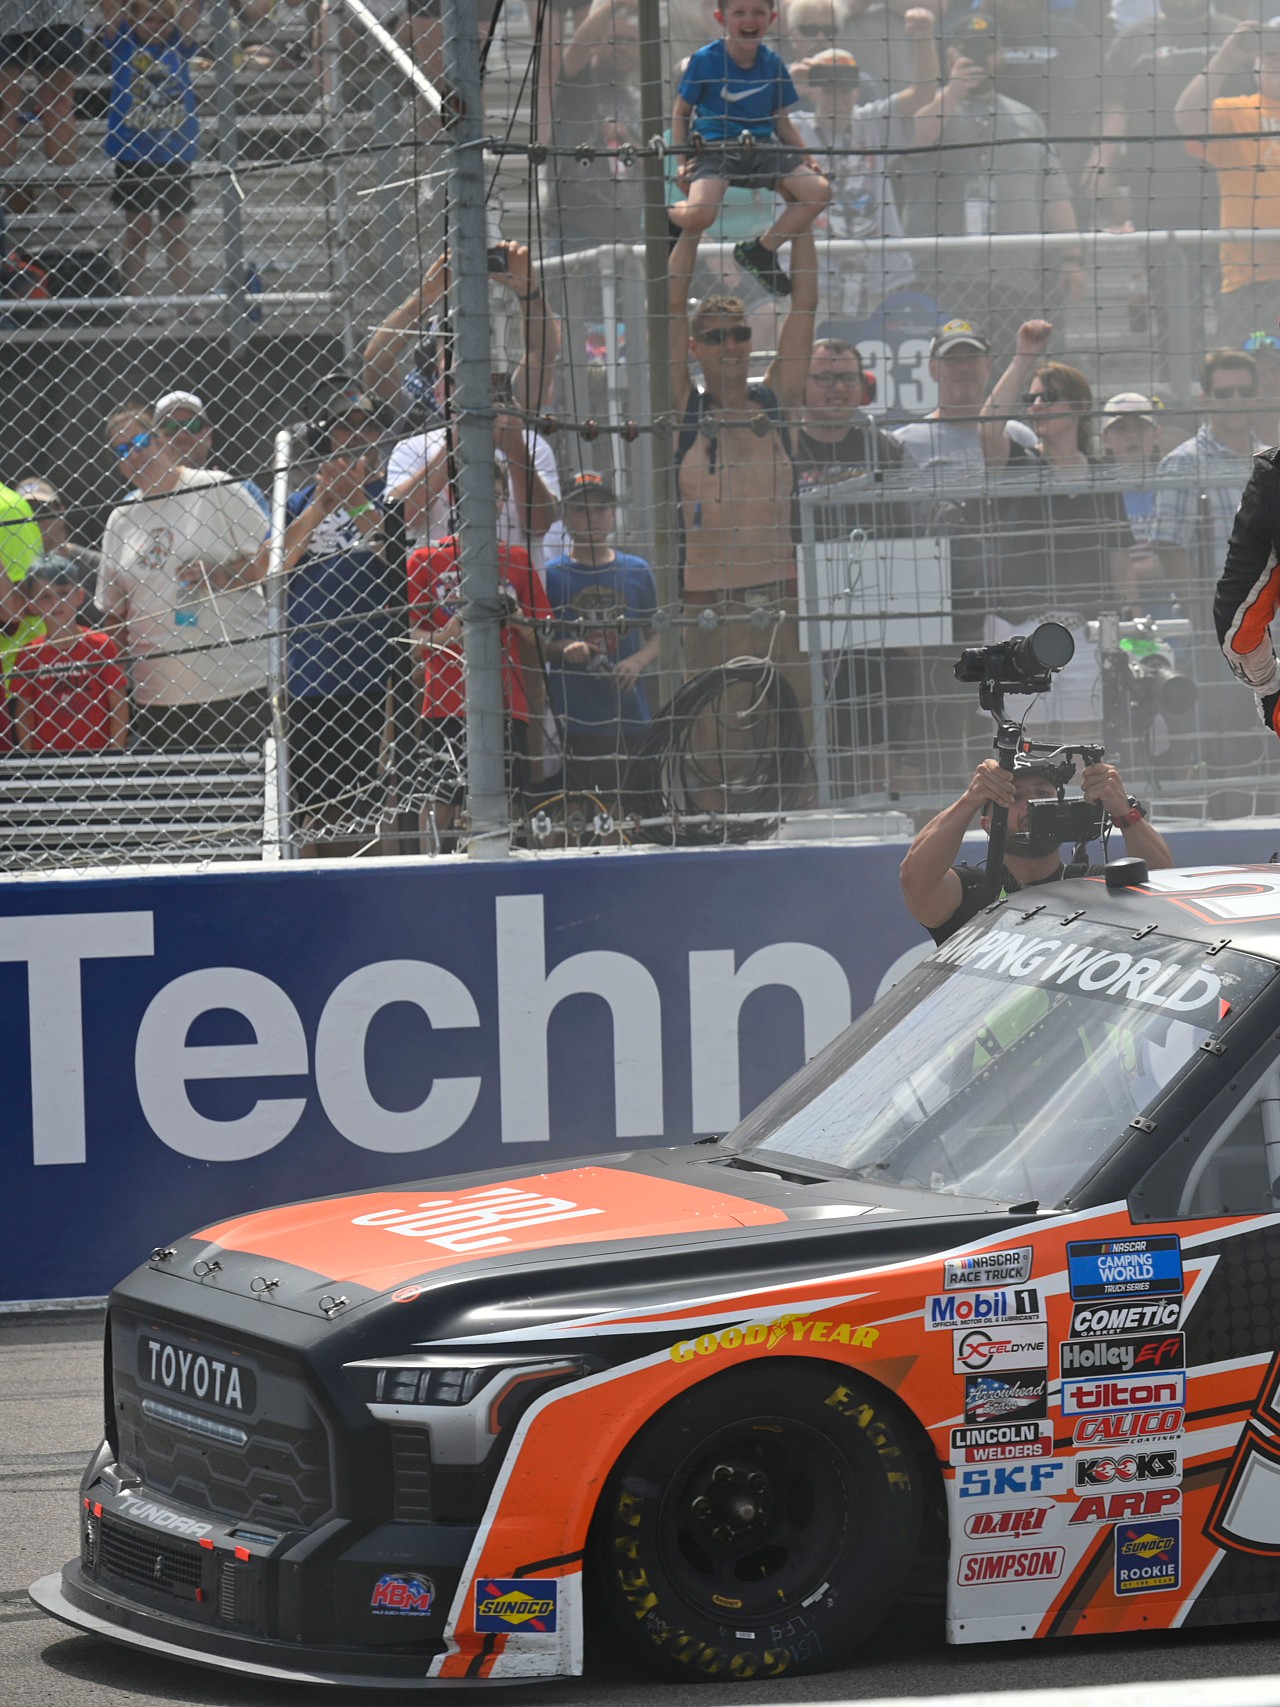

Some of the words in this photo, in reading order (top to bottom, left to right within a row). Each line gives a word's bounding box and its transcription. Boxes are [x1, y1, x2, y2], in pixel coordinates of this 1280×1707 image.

[1040, 943, 1220, 1011] WORLD
[351, 1188, 607, 1252] JBL
[1112, 1241, 1147, 1253] NASCAR
[972, 1252, 1020, 1269] NASCAR
[1097, 1253, 1153, 1269] CAMPING
[950, 1271, 981, 1284] RACE
[984, 1267, 1023, 1281] TRUCK
[1099, 1267, 1154, 1283] WORLD
[1104, 1283, 1126, 1293] TRUCK
[1126, 1282, 1150, 1291] SERIES
[932, 1291, 1007, 1322] Mobil
[932, 1320, 958, 1328] OFFICIAL
[960, 1318, 983, 1326] MOTOR
[983, 1316, 994, 1324] OIL
[1001, 1314, 1040, 1322] LUBRICANTS
[1074, 1303, 1180, 1332] COMETIC
[1081, 1328, 1122, 1337] GASKET
[957, 1340, 1045, 1361] XCELDYNE
[1062, 1342, 1134, 1371] Holley
[148, 1341, 244, 1410] TOYOTA
[966, 1381, 1046, 1402] Arrowhead
[1070, 1383, 1177, 1409] tilton
[984, 1400, 1018, 1413] Brass
[956, 1425, 1035, 1447] LINCOLN
[1075, 1410, 1182, 1442] CALICO
[1130, 1434, 1182, 1444] COATINGS
[973, 1444, 1043, 1461] WELDERS
[1076, 1451, 1175, 1485] KOOKS
[959, 1463, 1064, 1498] SKF
[1069, 1488, 1181, 1523] ARP
[118, 1497, 214, 1537] TUNDRA
[970, 1507, 1051, 1535] DART
[1123, 1538, 1174, 1553] SUNOCO
[964, 1550, 1058, 1582] SIMPSON
[1120, 1564, 1175, 1580] ROOKIE
[371, 1580, 431, 1610] KBM
[481, 1601, 551, 1615] SUNOCO
